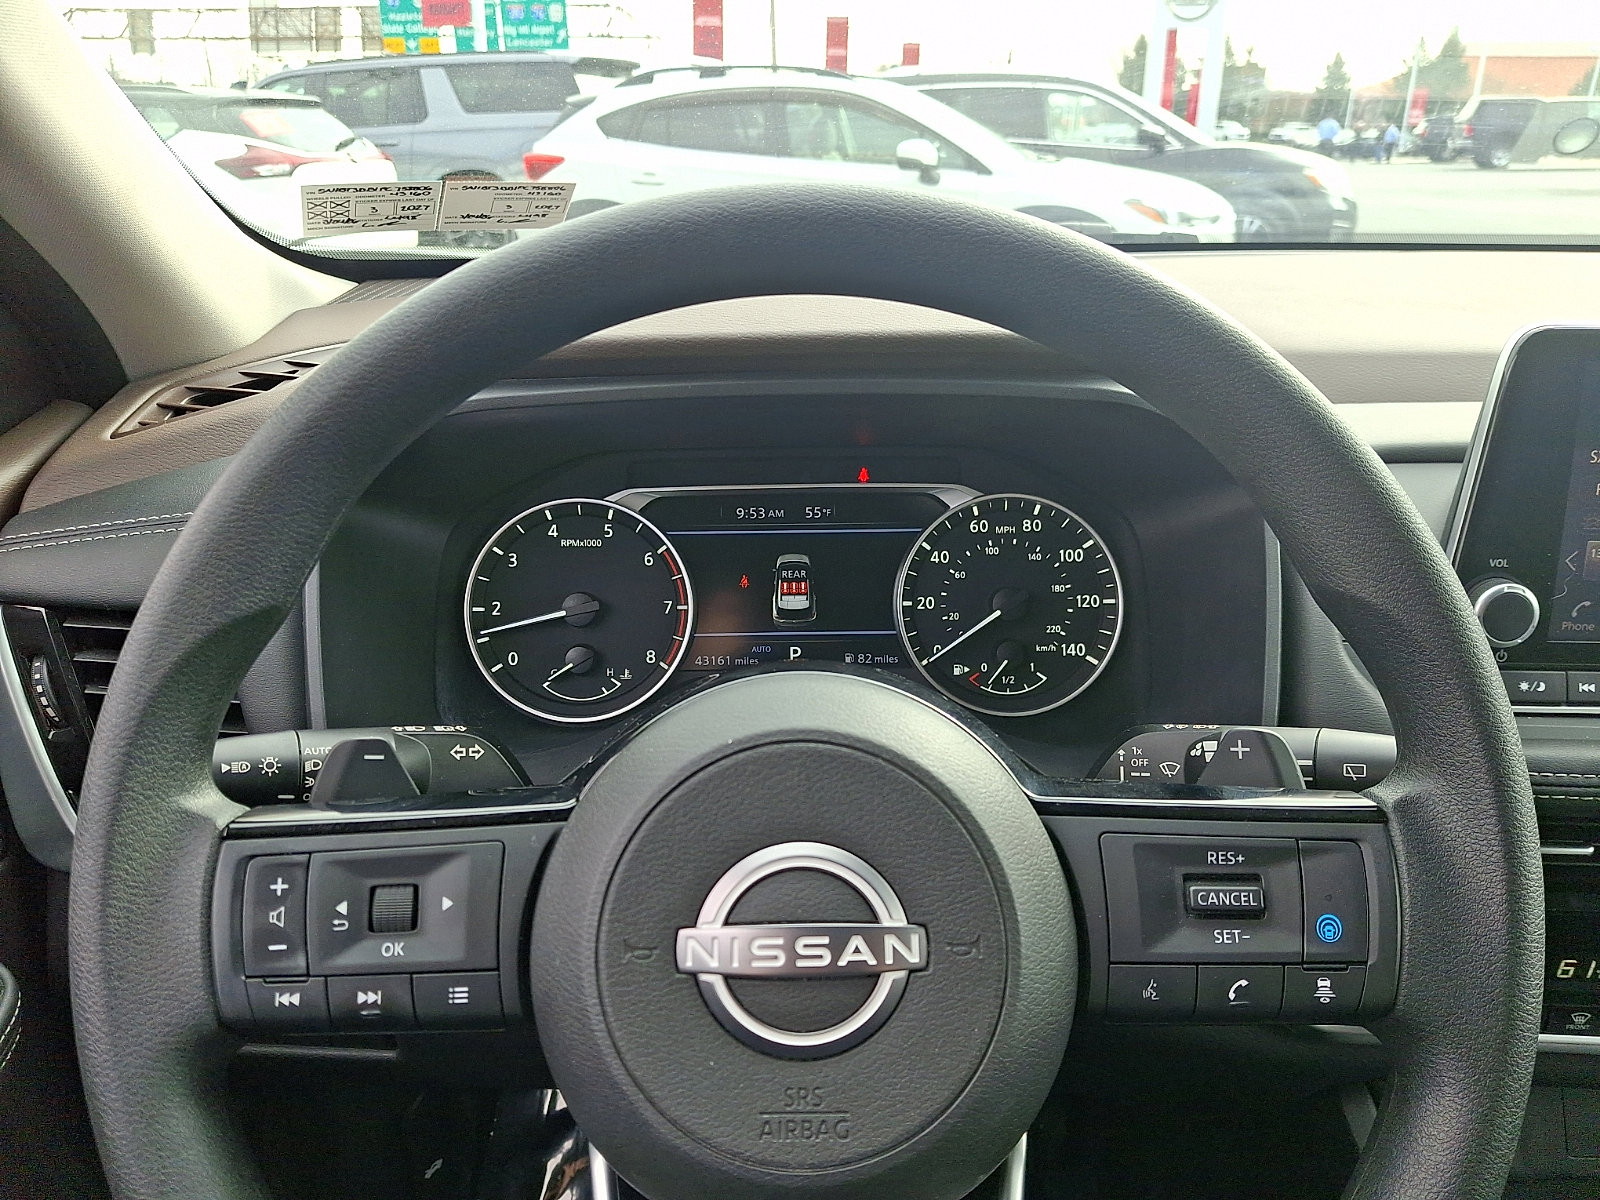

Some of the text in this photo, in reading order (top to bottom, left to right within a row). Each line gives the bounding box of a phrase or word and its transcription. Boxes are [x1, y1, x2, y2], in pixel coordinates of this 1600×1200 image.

[736, 507, 765, 519] 9:53
[768, 509, 784, 518] AM
[548, 524, 558, 537] 4
[604, 524, 614, 537] 5
[970, 520, 988, 533] 60
[996, 526, 1016, 534] MPH
[1022, 520, 1042, 532] 80
[560, 539, 602, 547] RPMx1000
[930, 551, 950, 563] 40
[985, 547, 999, 555] 100
[1059, 549, 1084, 562] 100
[508, 554, 518, 567] 3
[644, 553, 654, 566] 6
[1490, 559, 1508, 568] VOL
[782, 570, 807, 578] REAR
[663, 601, 672, 614] 7
[917, 597, 935, 609] 20
[1076, 595, 1100, 608] 120
[491, 602, 501, 616] 2
[1562, 621, 1595, 631] Phone
[790, 647, 802, 660] P
[1036, 644, 1057, 653] km/h
[1061, 644, 1086, 656] 140
[508, 652, 518, 665] 0
[646, 651, 656, 664] 8
[695, 656, 759, 666] 43161 miles
[858, 654, 898, 664] 82 miles
[606, 668, 614, 676] H
[981, 663, 987, 672] 0
[1030, 663, 1034, 671] 1
[1002, 676, 1015, 684] 1/2
[1131, 758, 1149, 767] OFF
[1197, 892, 1258, 906] CANCEL
[381, 942, 405, 956] OK
[686, 933, 920, 968] NISSAN
[783, 1086, 822, 1107] SRS
[759, 1119, 850, 1143] AIRBAG
